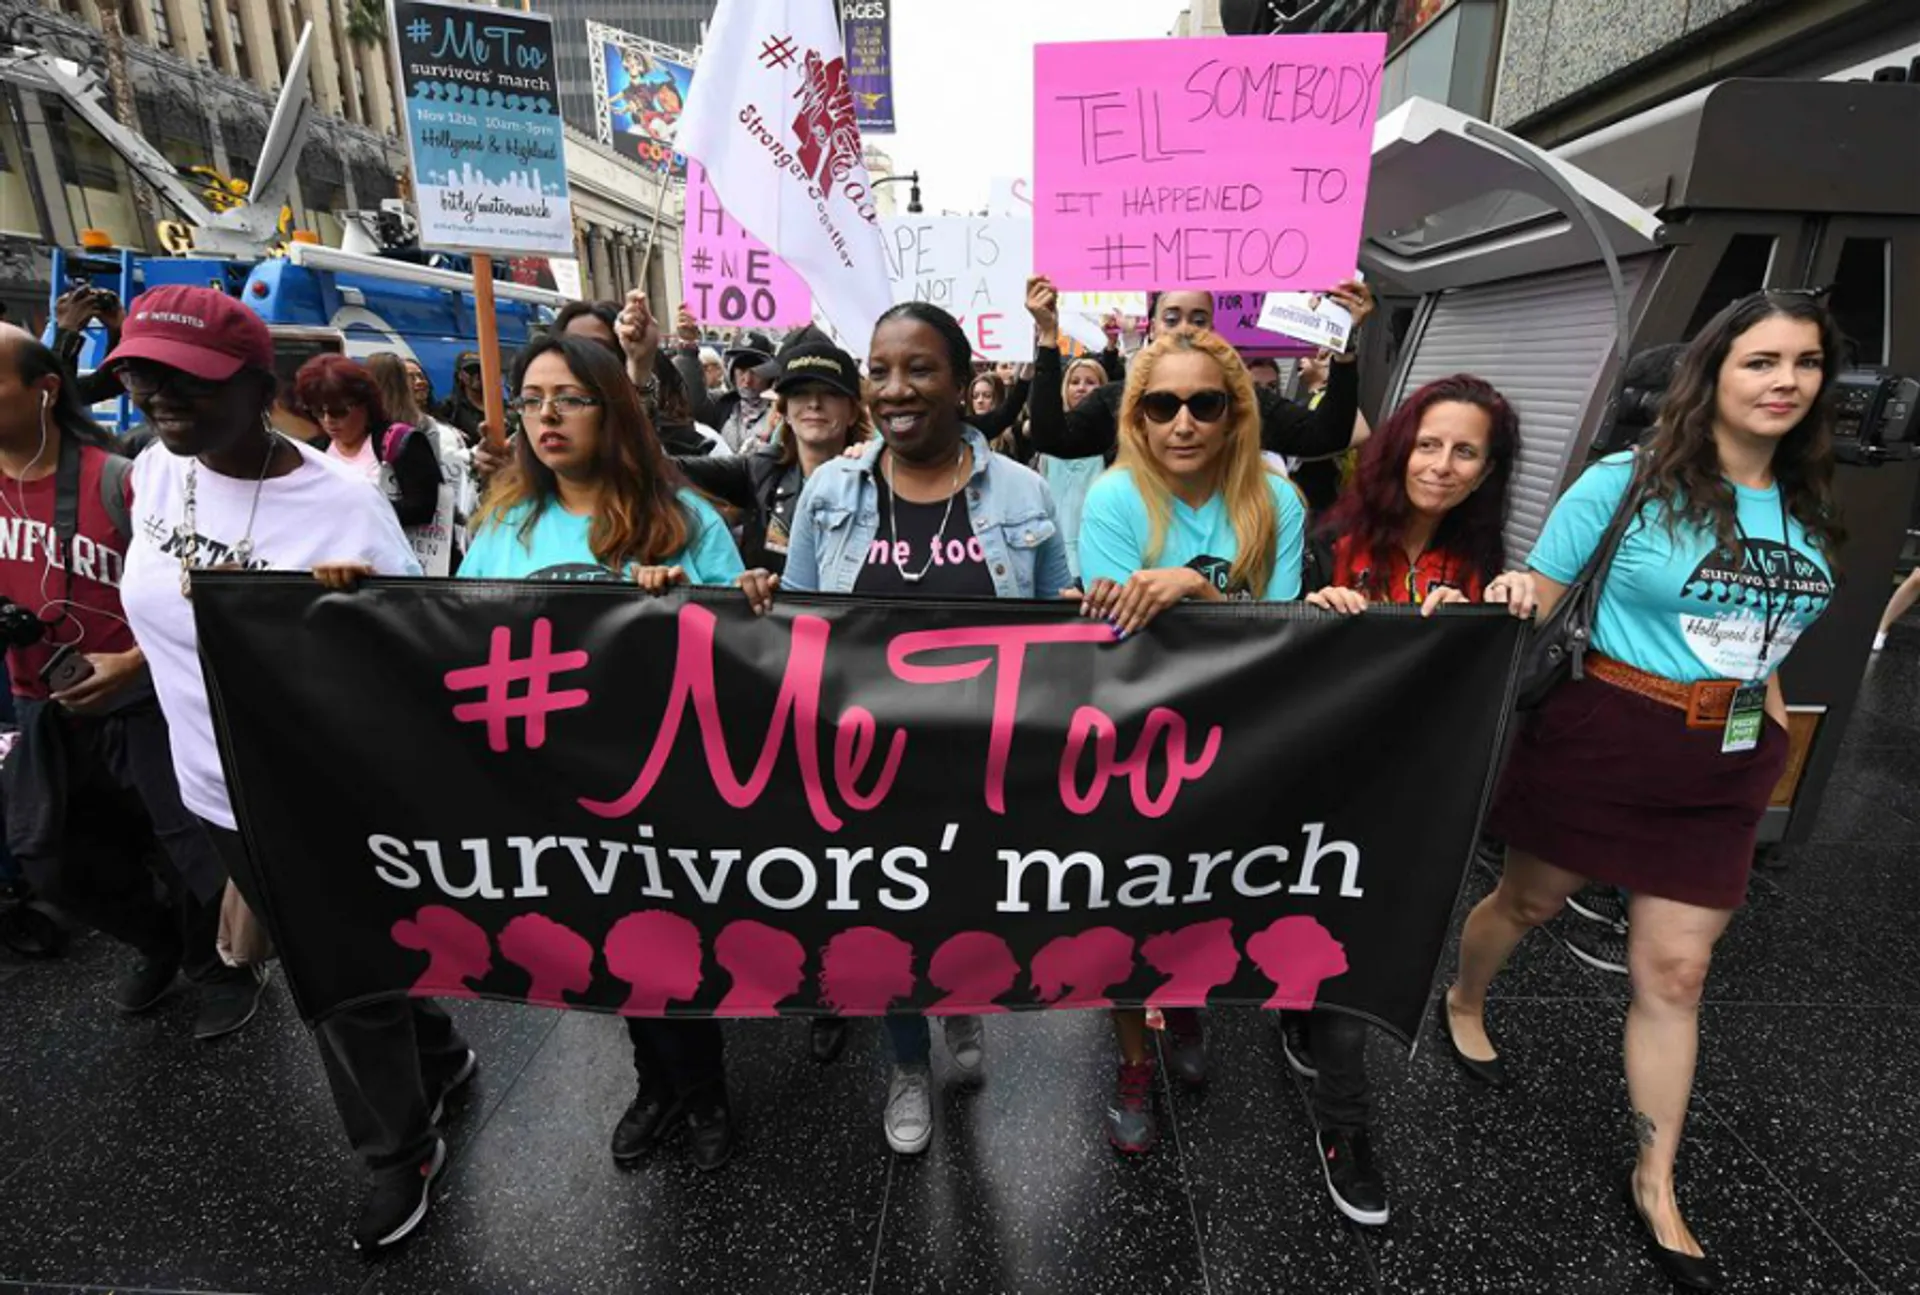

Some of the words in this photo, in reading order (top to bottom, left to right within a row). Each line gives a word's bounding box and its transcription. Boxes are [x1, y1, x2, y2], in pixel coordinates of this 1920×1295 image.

[484, 26, 547, 70] Too
[410, 62, 493, 83] survivors'
[497, 73, 551, 91] march
[417, 108, 445, 122] Nov
[448, 110, 477, 127] 12th
[1055, 87, 1206, 167] TELL
[1184, 59, 1382, 129] SOMEBODY
[421, 128, 485, 159] Hollywood
[488, 134, 500, 152] &
[738, 104, 809, 181] Stronger
[1055, 191, 1102, 217] IT
[1122, 183, 1263, 218] HAPPENED
[1291, 167, 1349, 204] TO
[965, 224, 1000, 268] IS
[1087, 228, 1310, 282] #METOO
[692, 282, 777, 323] TOO
[913, 277, 956, 304] NOT
[970, 277, 992, 309] A
[1218, 295, 1243, 311] FOR
[929, 533, 987, 567] too
[1685, 617, 1747, 647] Hollywood
[886, 621, 1223, 819] Too
[367, 822, 958, 912] survivors'
[996, 822, 1365, 915] march
